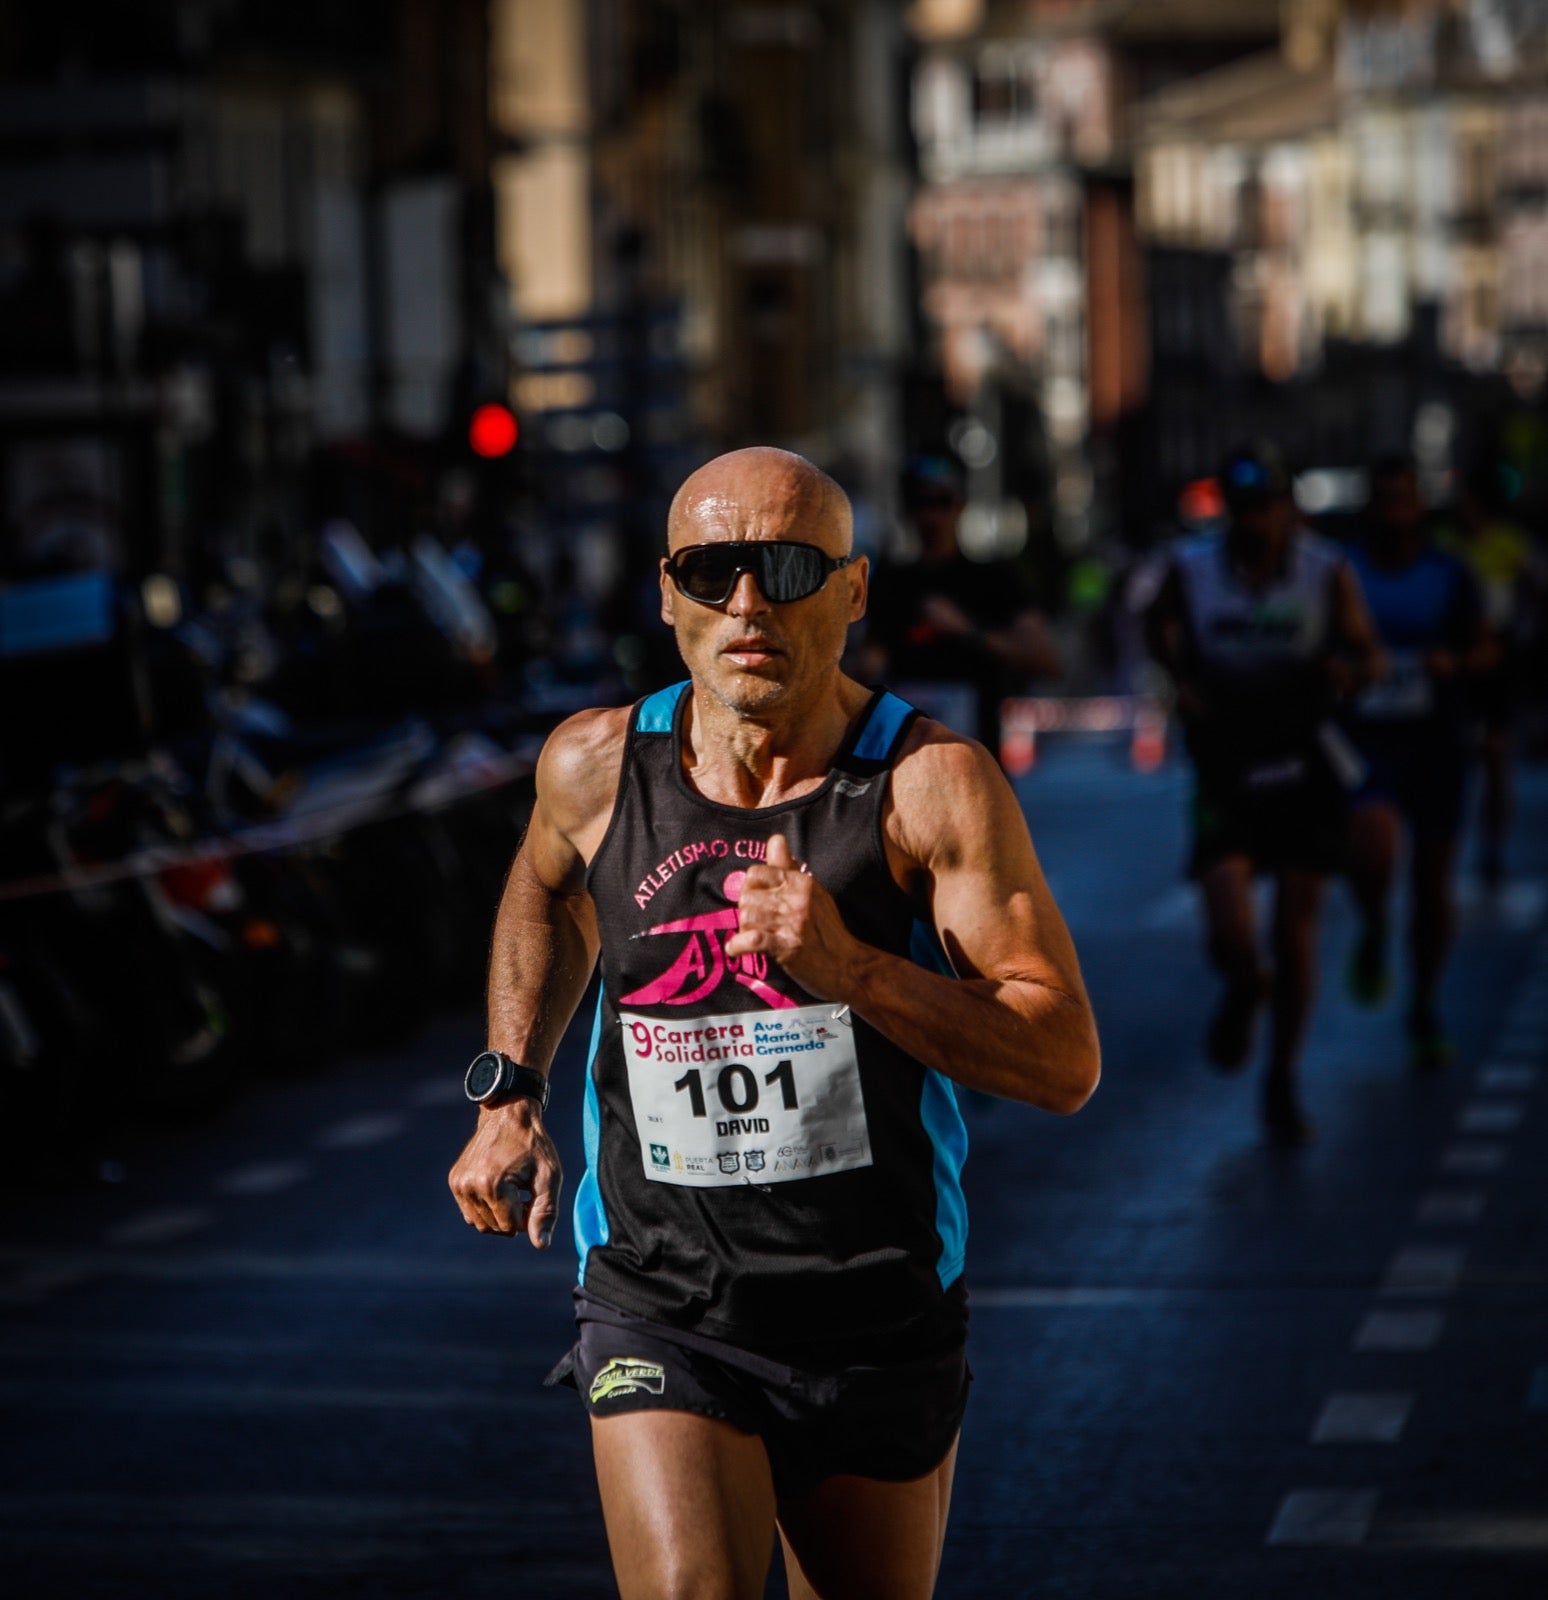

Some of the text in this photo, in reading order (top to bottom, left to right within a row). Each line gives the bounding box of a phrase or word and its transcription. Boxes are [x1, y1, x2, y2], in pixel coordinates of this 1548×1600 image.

[634, 839, 729, 910] ATLETISMO
[754, 1021, 783, 1033] Ave
[755, 1031, 800, 1044] María
[632, 1021, 745, 1058] 9 Carrera
[756, 1039, 825, 1056] Granada
[655, 1040, 754, 1063] Solidaria
[674, 1059, 799, 1117] 101
[716, 1117, 770, 1137] DAVID
